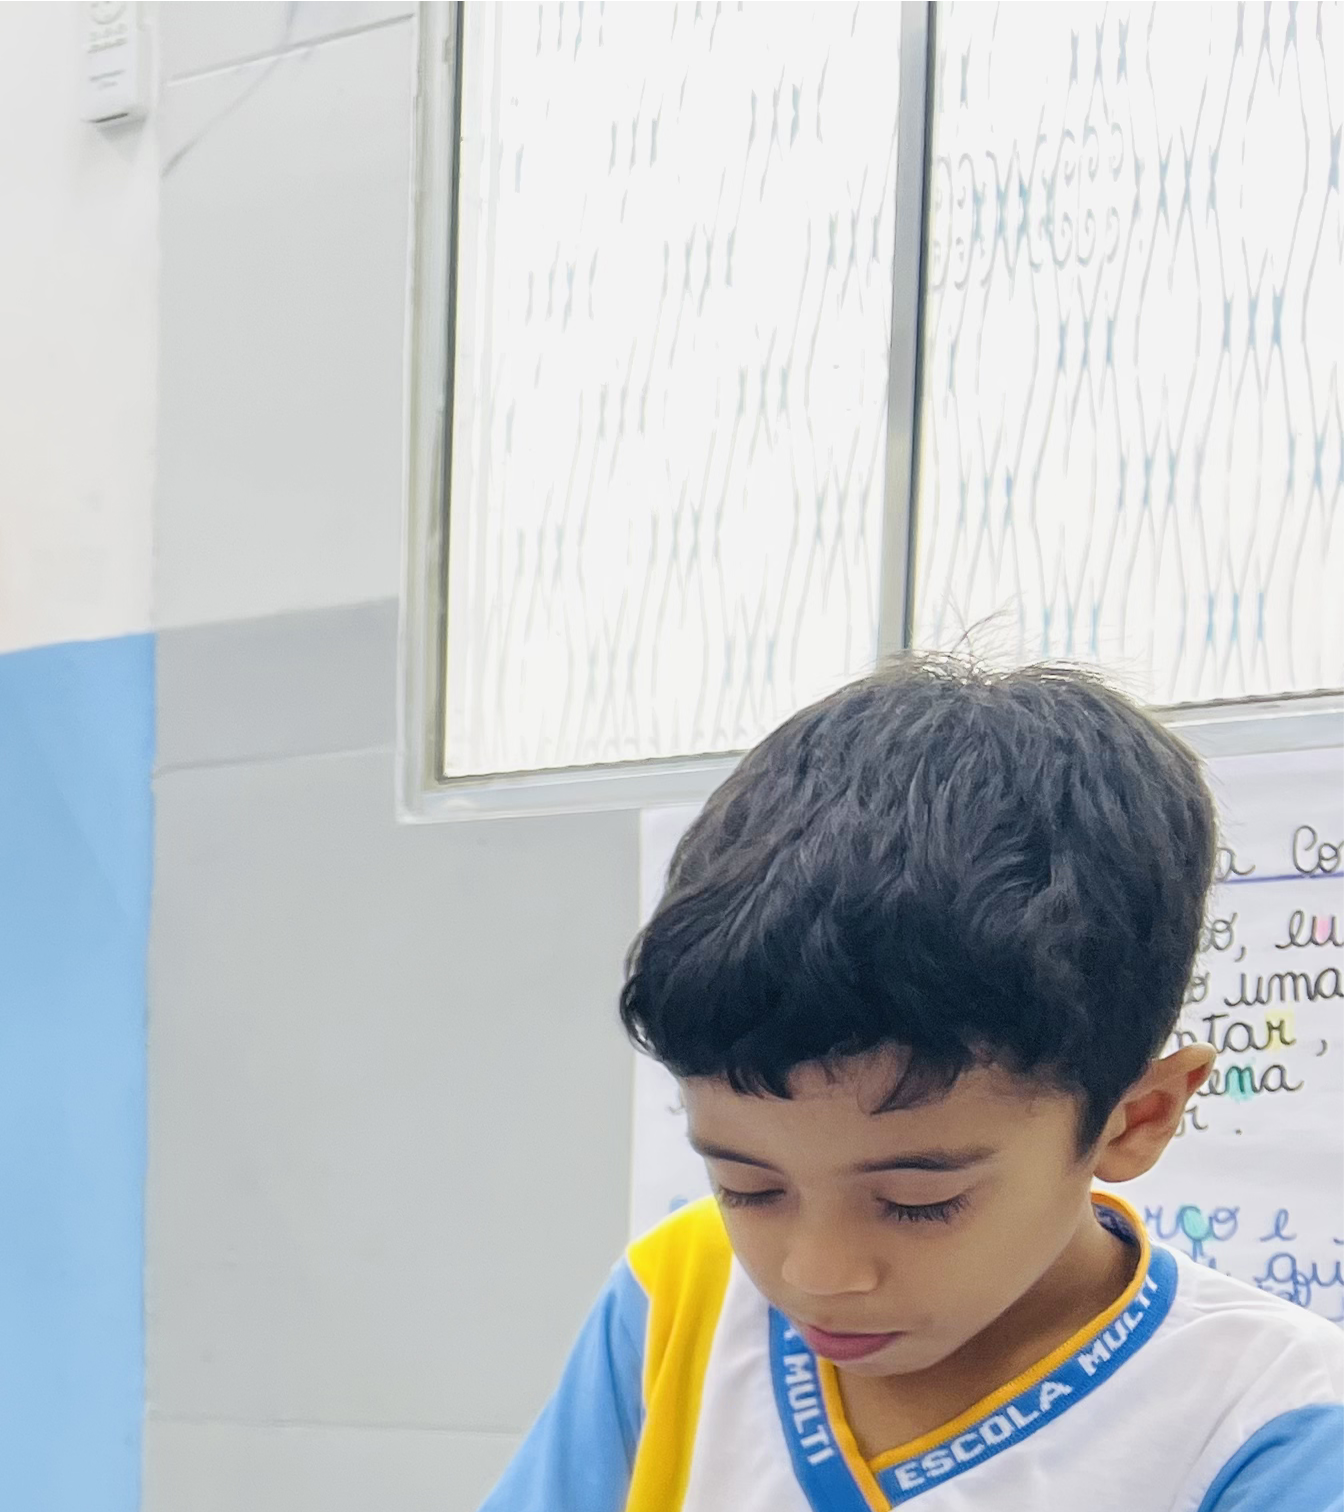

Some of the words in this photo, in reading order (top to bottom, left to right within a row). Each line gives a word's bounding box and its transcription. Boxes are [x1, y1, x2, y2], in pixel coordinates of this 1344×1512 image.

[1224, 966, 1344, 1007] uma
[781, 1352, 835, 1465] MULTI
[893, 1378, 1074, 1491] ESCOLA
[1075, 1273, 1159, 1378] MULTI
